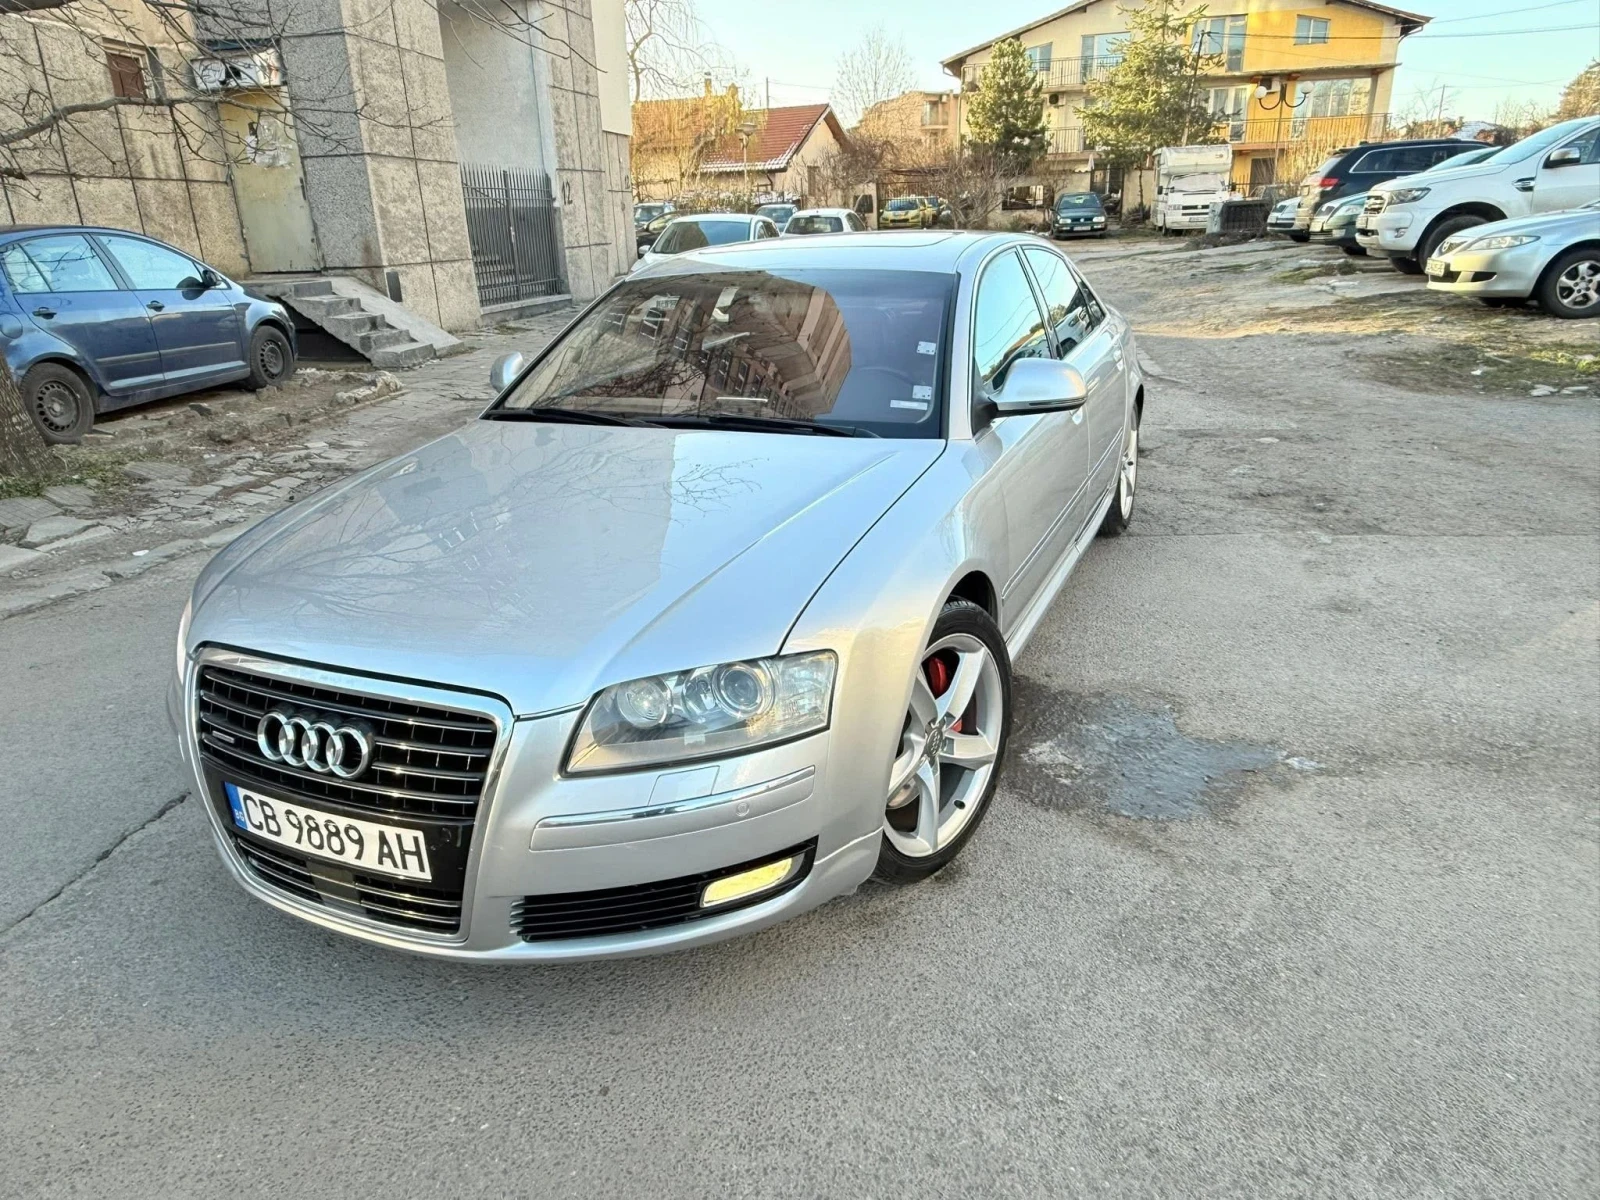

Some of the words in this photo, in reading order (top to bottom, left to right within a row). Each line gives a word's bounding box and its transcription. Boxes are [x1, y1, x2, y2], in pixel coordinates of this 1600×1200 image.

[562, 181, 573, 205] 12
[242, 793, 282, 837] CB
[284, 808, 365, 861] 9889
[377, 829, 426, 874] AH
